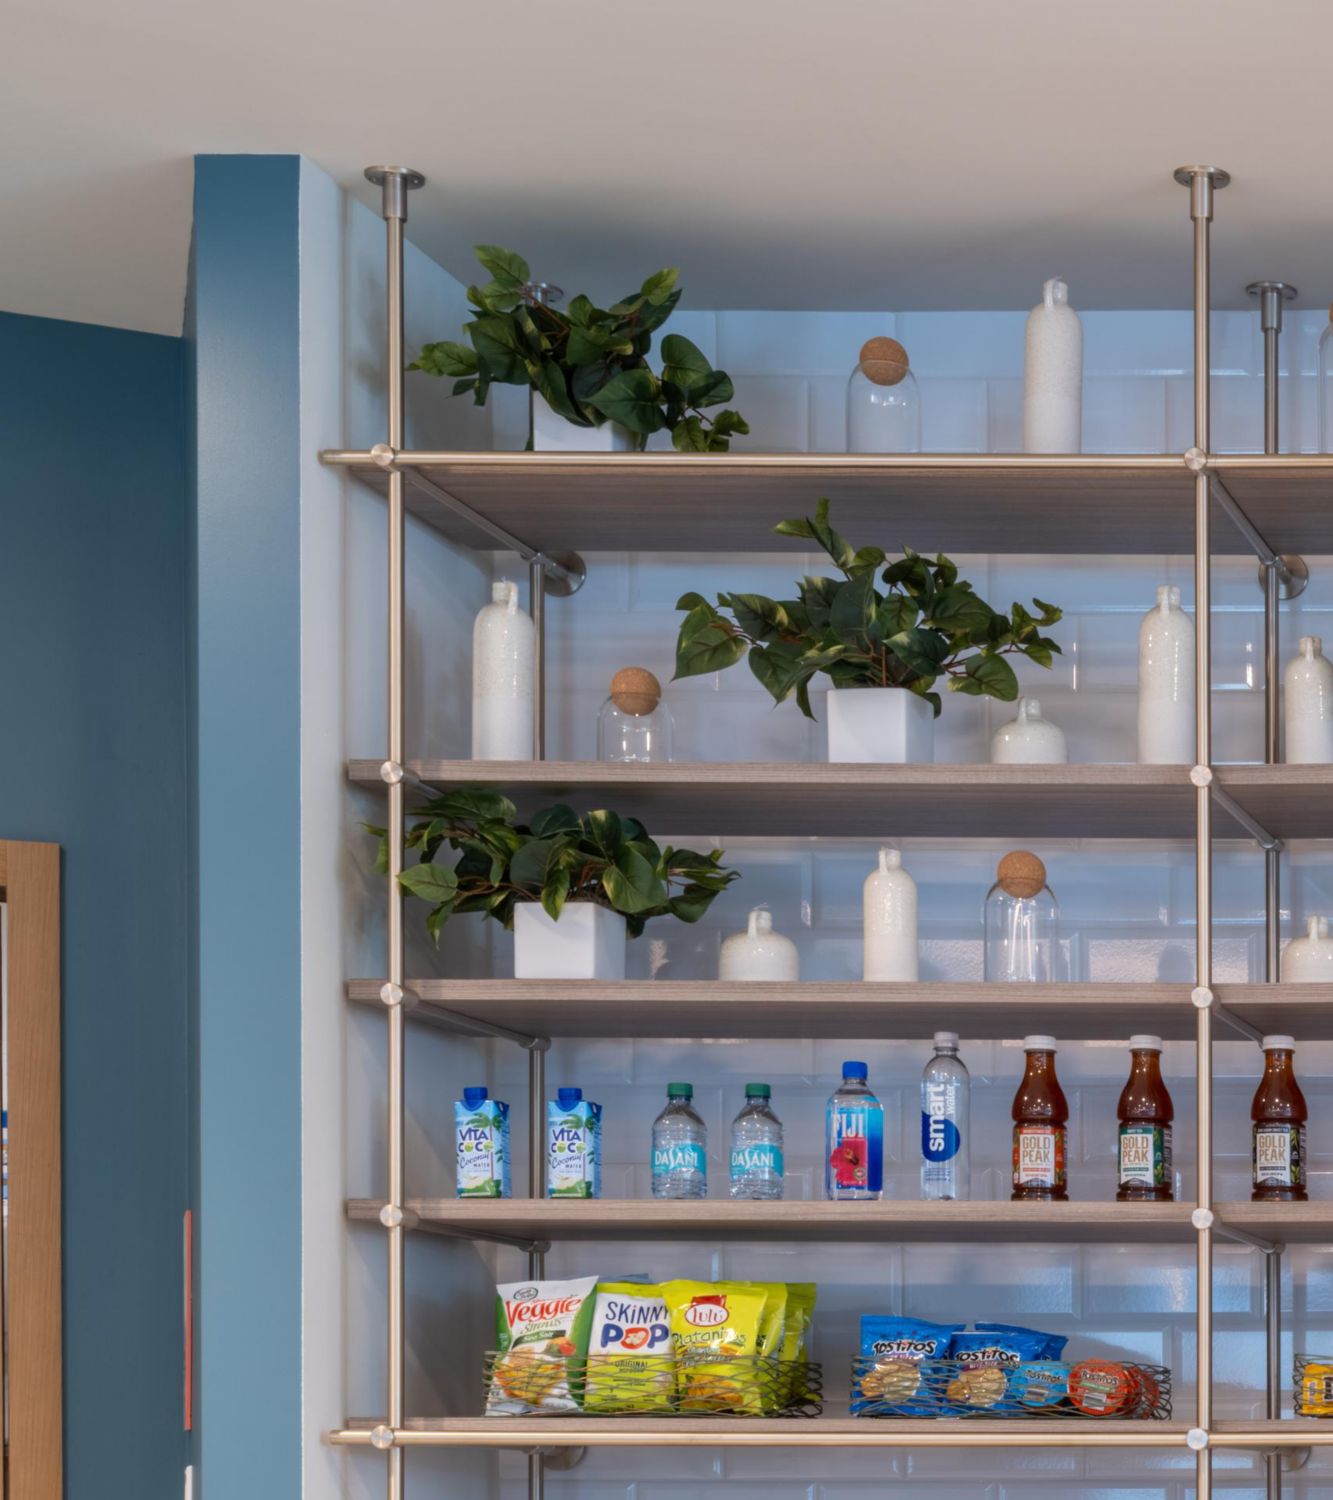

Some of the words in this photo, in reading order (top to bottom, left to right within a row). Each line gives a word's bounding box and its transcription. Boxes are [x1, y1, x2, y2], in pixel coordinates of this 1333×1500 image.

[945, 1084, 956, 1115] water
[928, 1083, 945, 1151] smart
[832, 1113, 864, 1138] FIJI
[459, 1127, 489, 1141] VITA
[552, 1127, 582, 1141] VITA
[1259, 1135, 1286, 1148] GOLD
[1022, 1136, 1050, 1149] GOLD
[1122, 1136, 1149, 1149] GOLD
[459, 1153, 490, 1169] Coconut
[551, 1153, 582, 1169] Coconut
[654, 1148, 698, 1169] DASANI
[731, 1148, 774, 1169] DASANI
[1022, 1150, 1050, 1162] PEAK
[1122, 1150, 1149, 1162] PEAK
[1259, 1149, 1286, 1161] PEAK
[505, 1298, 581, 1329] Veggie
[601, 1323, 669, 1350] POP
